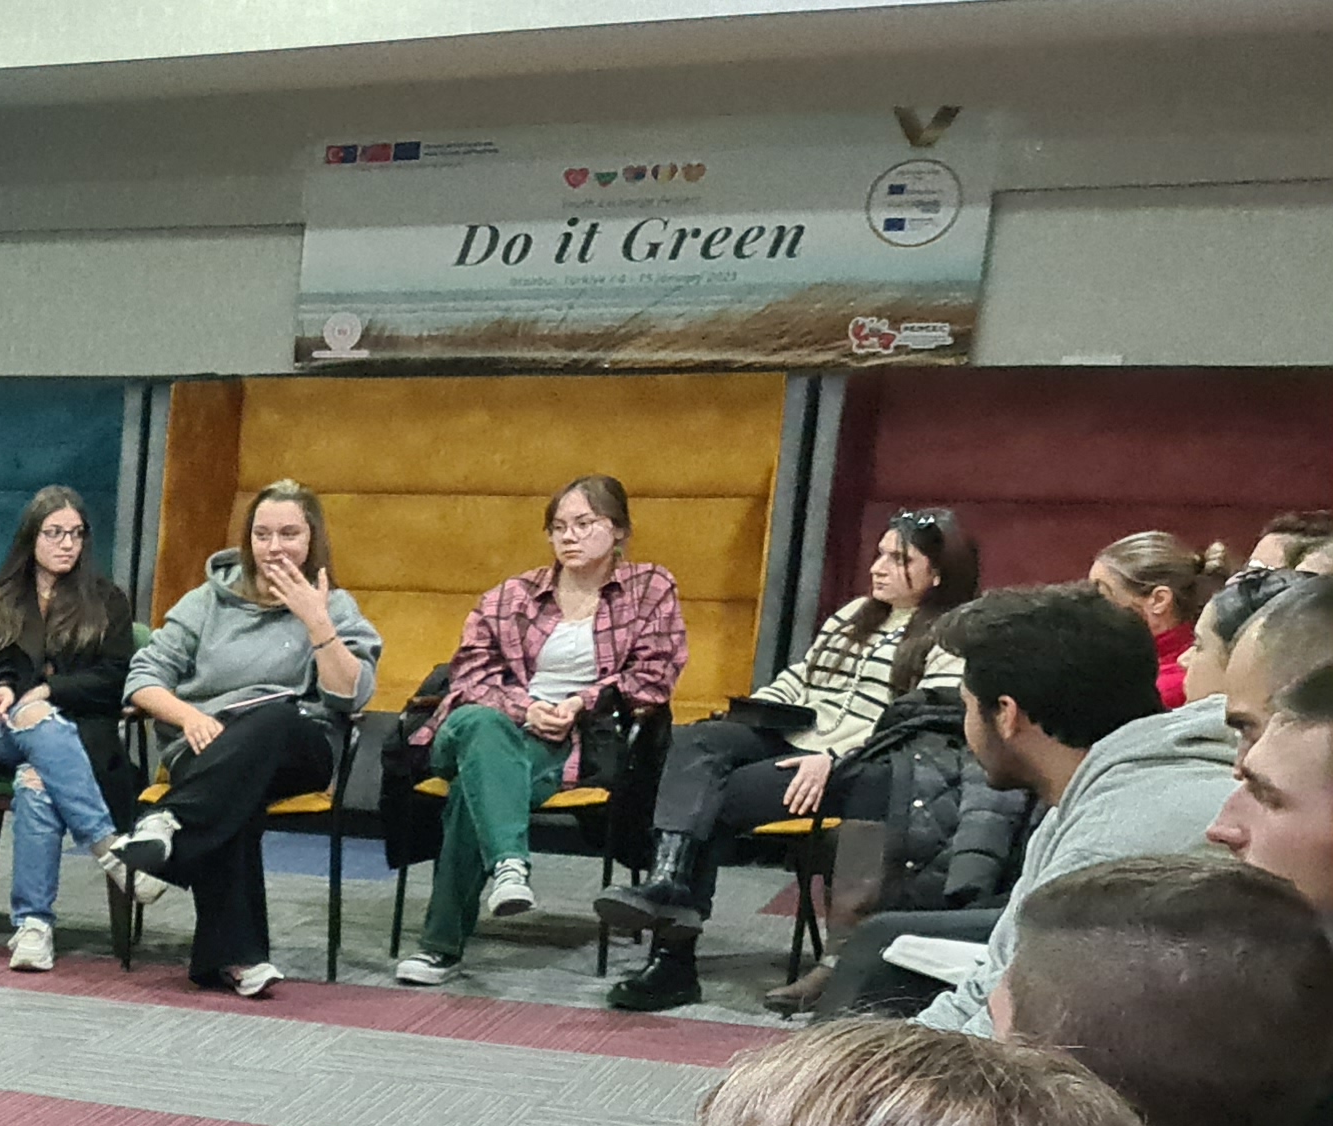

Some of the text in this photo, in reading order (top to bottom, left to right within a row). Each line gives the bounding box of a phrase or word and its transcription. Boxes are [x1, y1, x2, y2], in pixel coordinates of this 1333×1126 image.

[452, 217, 806, 266] Do it Green
